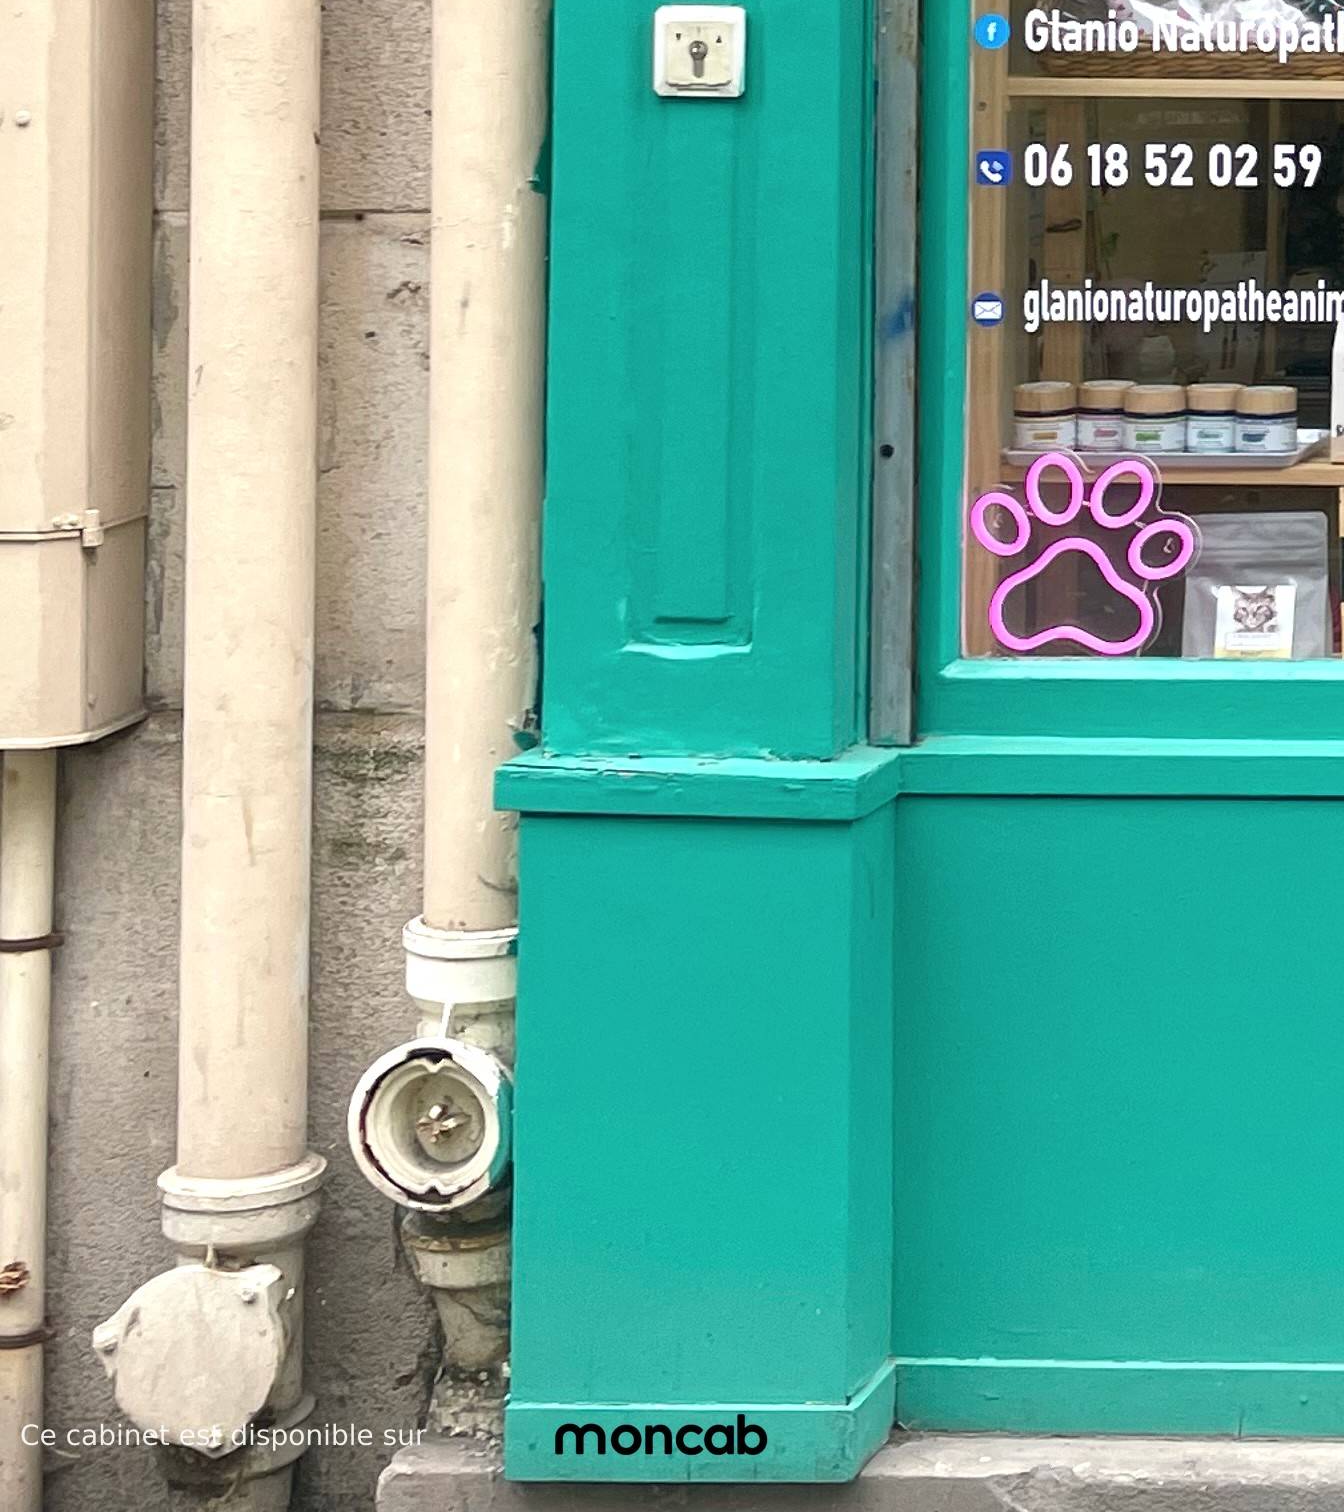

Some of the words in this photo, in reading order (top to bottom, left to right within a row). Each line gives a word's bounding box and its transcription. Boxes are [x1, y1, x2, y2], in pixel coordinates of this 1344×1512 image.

[1024, 8, 1140, 52] Glanio
[1024, 143, 1073, 187] 06
[1087, 143, 1130, 187] 18
[1144, 143, 1194, 187] 52
[1208, 144, 1258, 188] 02
[1273, 144, 1322, 188] 59
